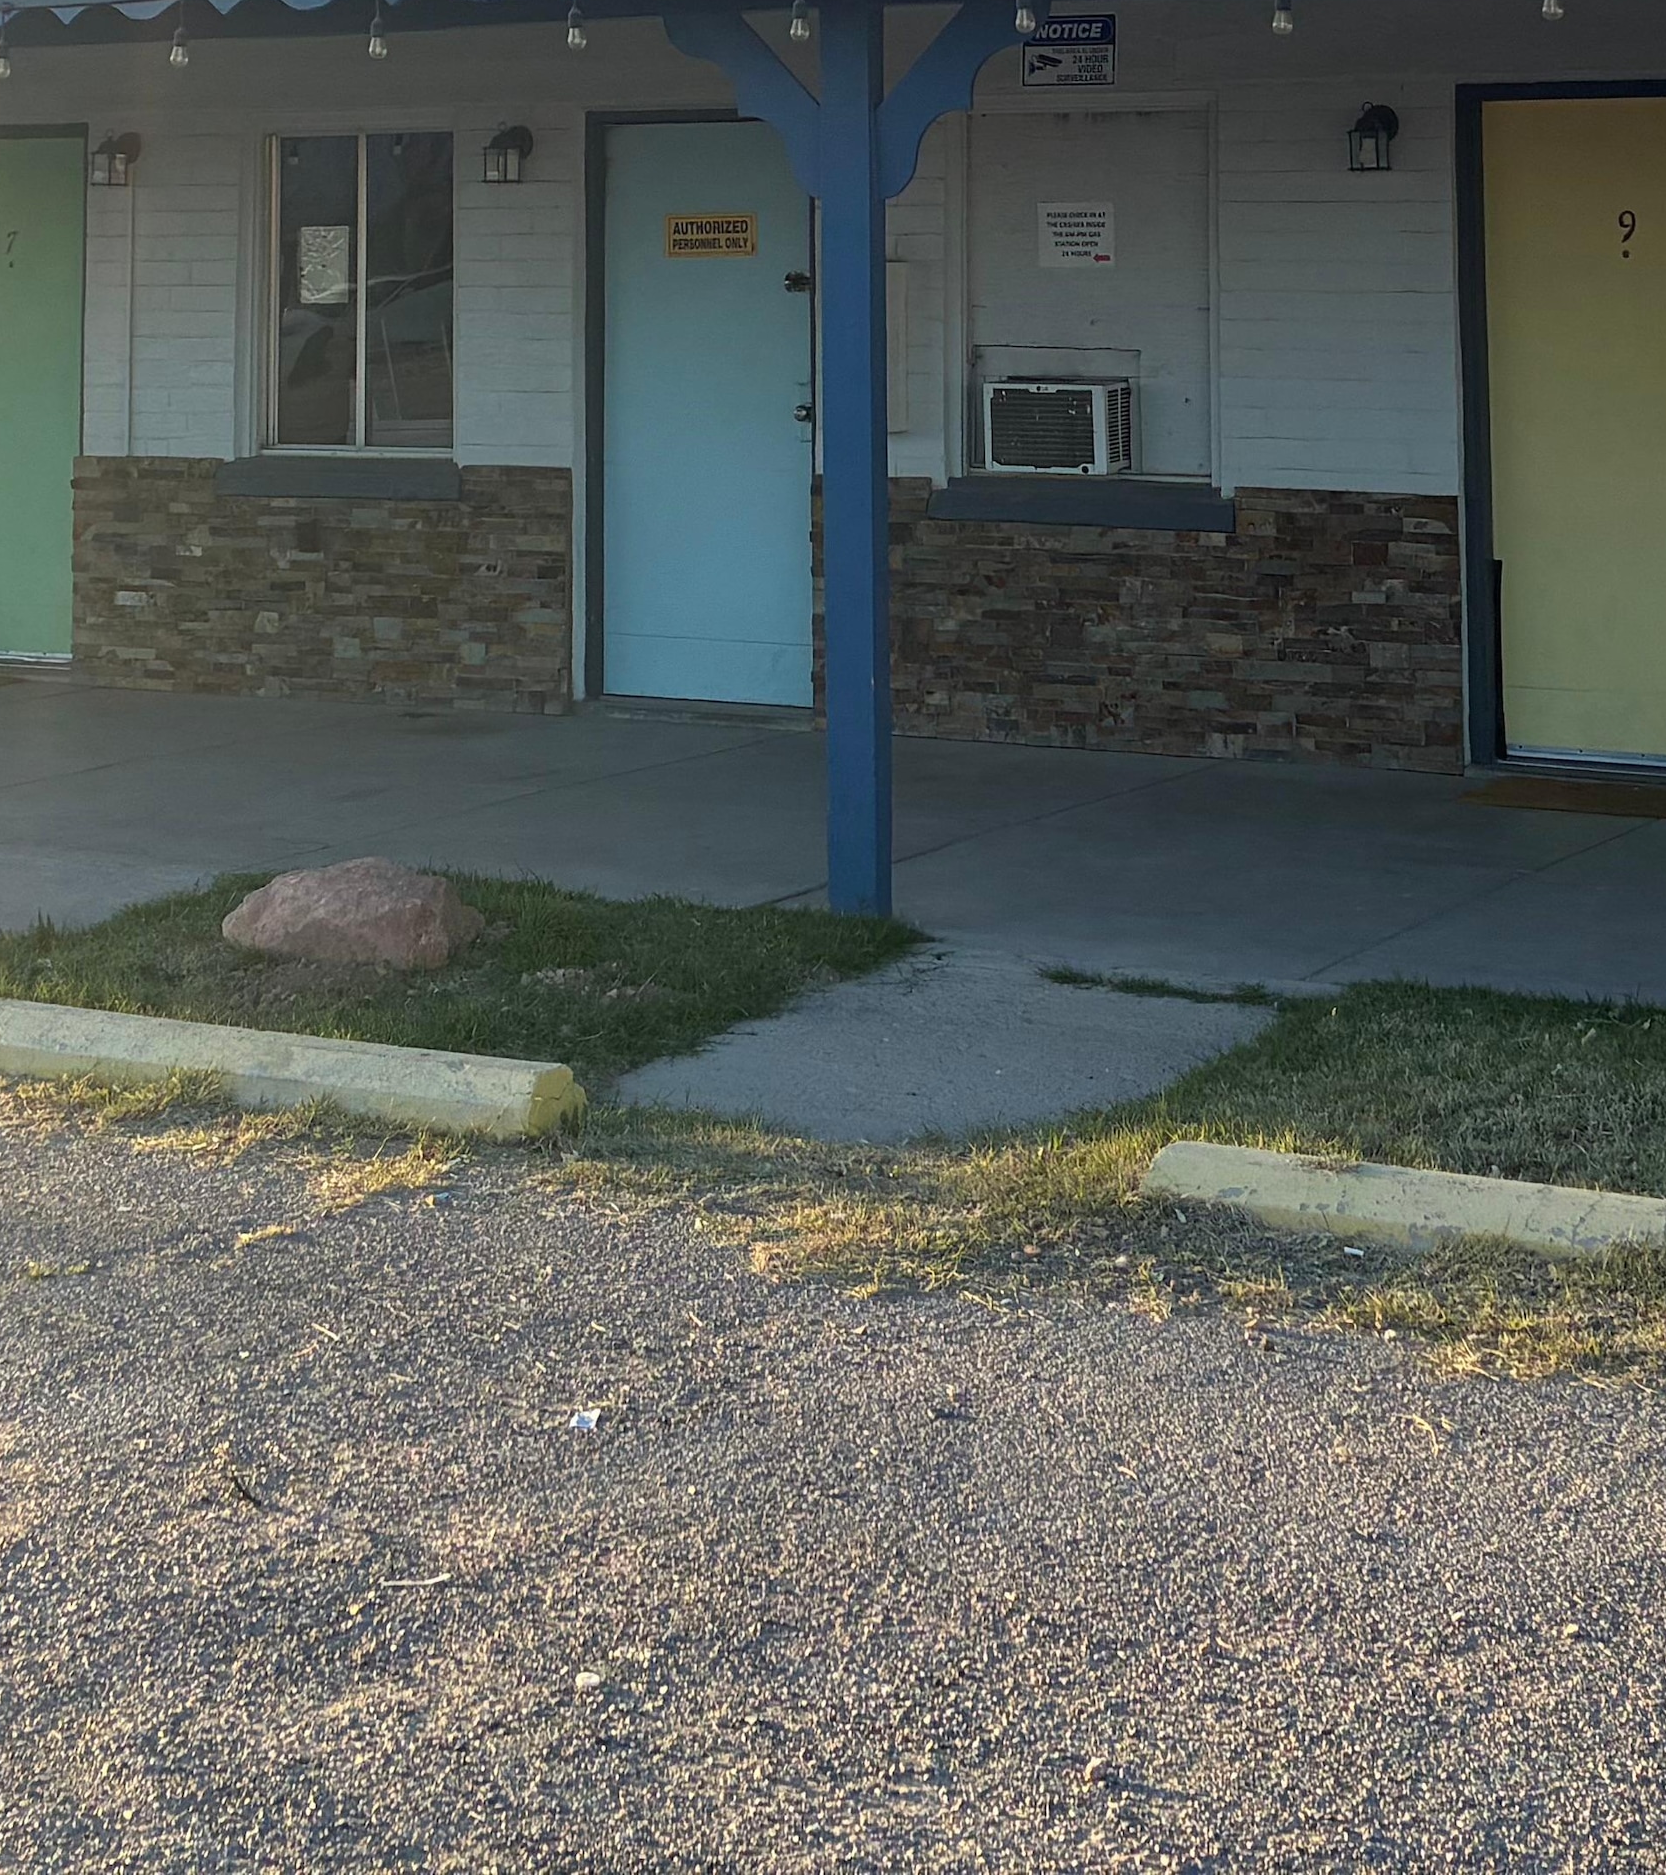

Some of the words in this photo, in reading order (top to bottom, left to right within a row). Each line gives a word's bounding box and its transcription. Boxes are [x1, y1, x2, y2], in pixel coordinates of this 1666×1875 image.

[1036, 23, 1102, 38] NOTICE
[1072, 55, 1083, 64] 24
[1085, 54, 1109, 63] HOUR
[1078, 64, 1103, 73] VIDEO
[673, 220, 749, 235] AUTHORIZED
[1618, 210, 1636, 243] 9
[6, 231, 20, 255] 7
[672, 238, 723, 250] PERSONNEL
[724, 237, 749, 249] ONLY
